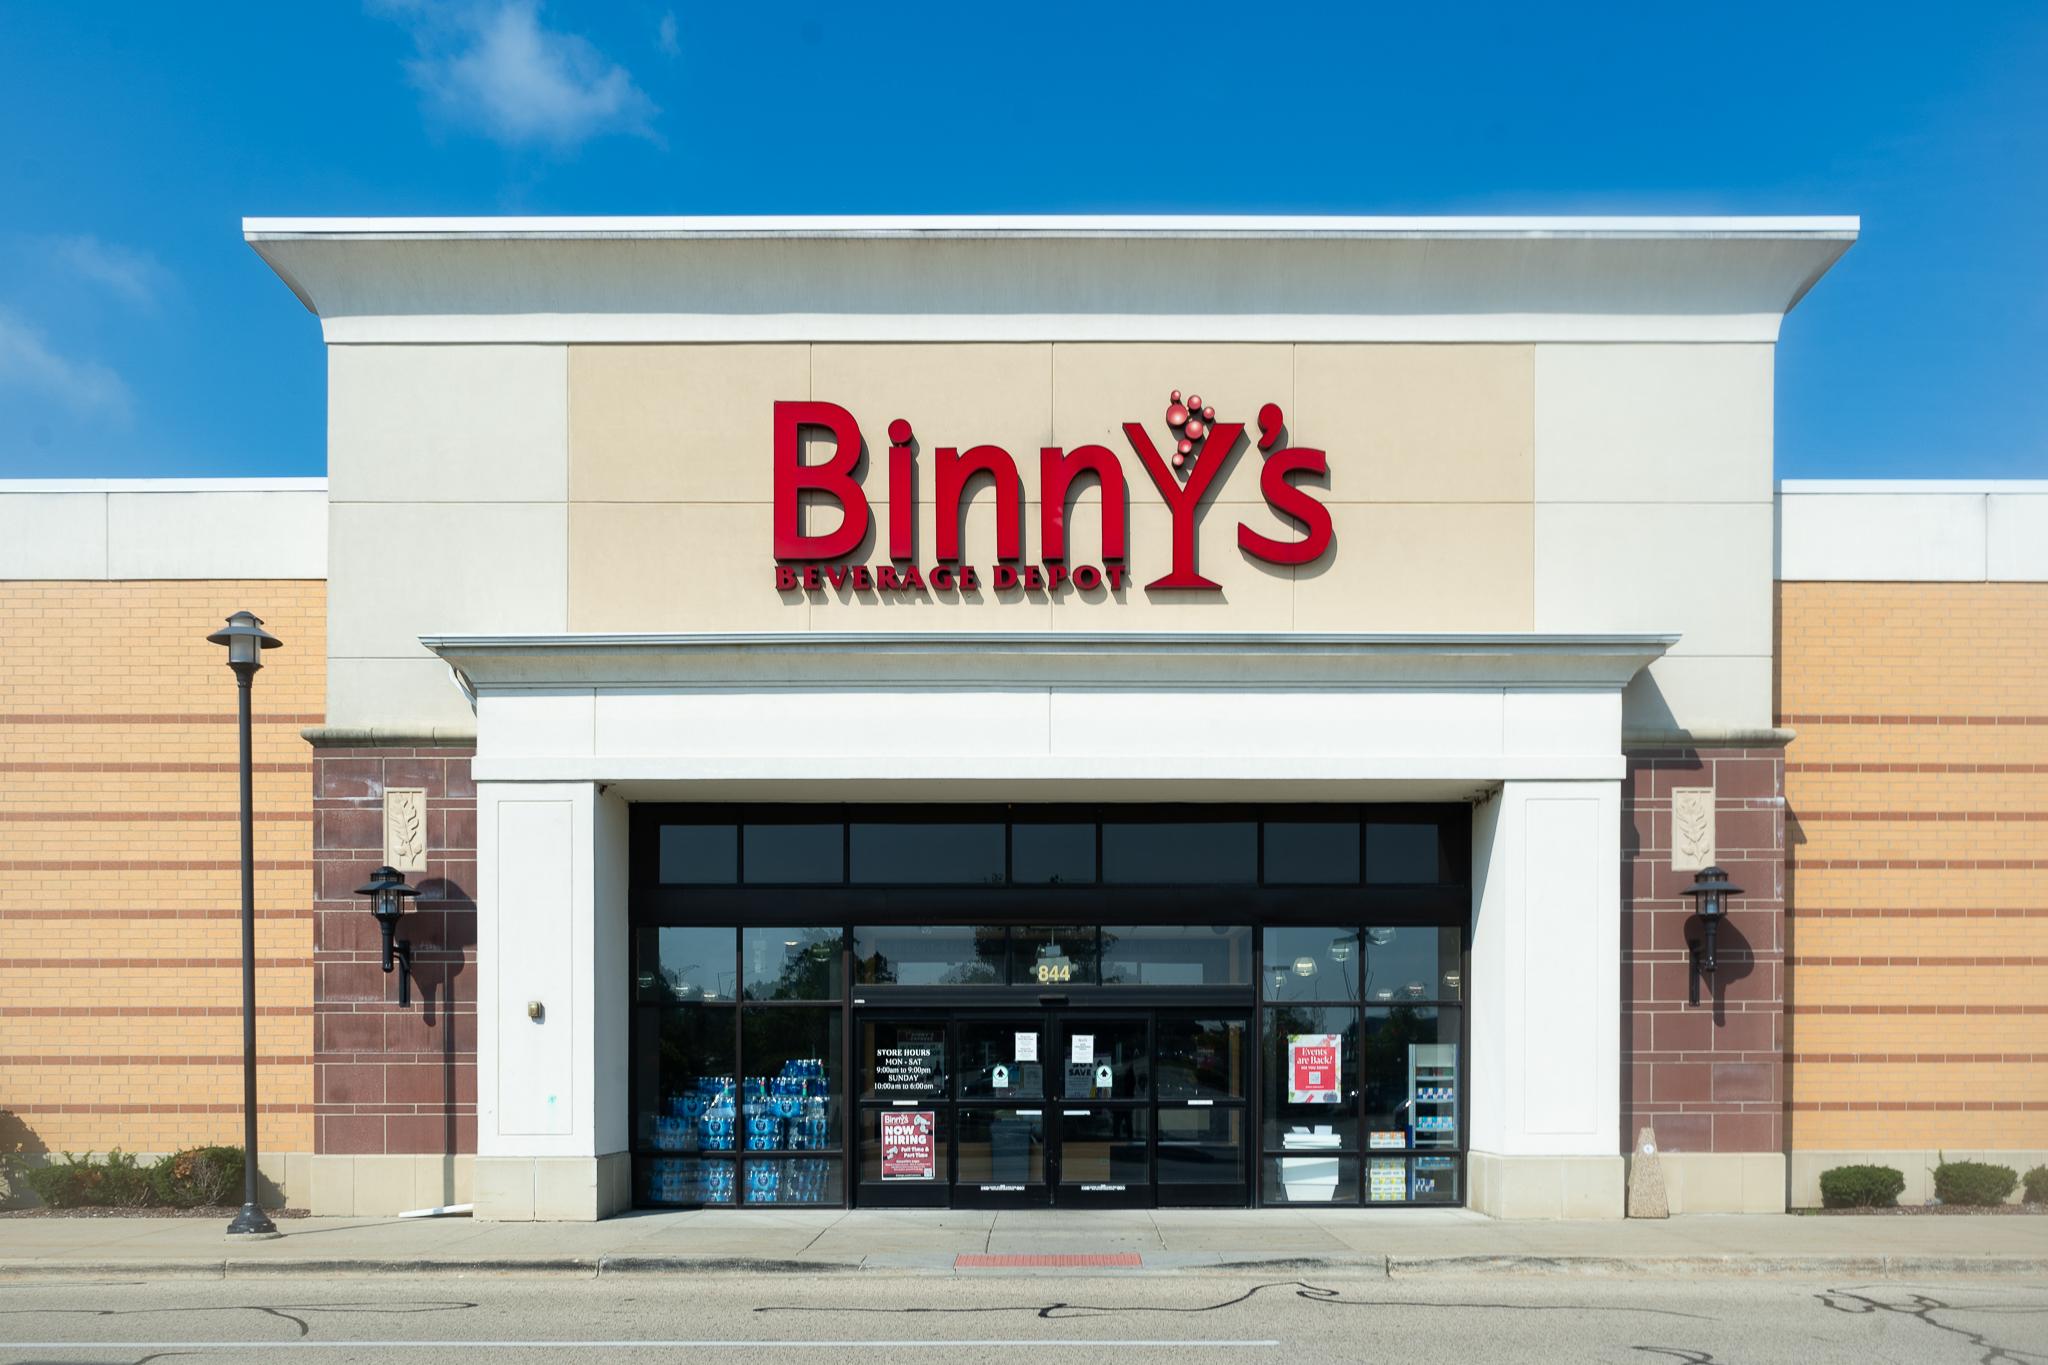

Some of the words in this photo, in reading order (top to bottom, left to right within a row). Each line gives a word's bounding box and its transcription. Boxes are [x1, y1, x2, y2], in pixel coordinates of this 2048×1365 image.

[775, 565, 977, 591] BEVERAGE
[993, 565, 1127, 591] DEPOT
[1038, 965, 1071, 982] 844
[876, 1048, 903, 1057] STORE
[904, 1048, 931, 1057] HOURS
[1302, 1047, 1328, 1056] Events
[885, 1058, 903, 1066] MON
[908, 1058, 923, 1066] SAT
[1297, 1057, 1310, 1065] are
[1311, 1056, 1333, 1065] Back!
[907, 1067, 931, 1075] 9:00pm
[1069, 1068, 1092, 1076] SAVE
[874, 1082, 901, 1090] 10:00am
[902, 1082, 909, 1090] to
[884, 1125, 915, 1135] NOW
[884, 1135, 927, 1145] HIRING
